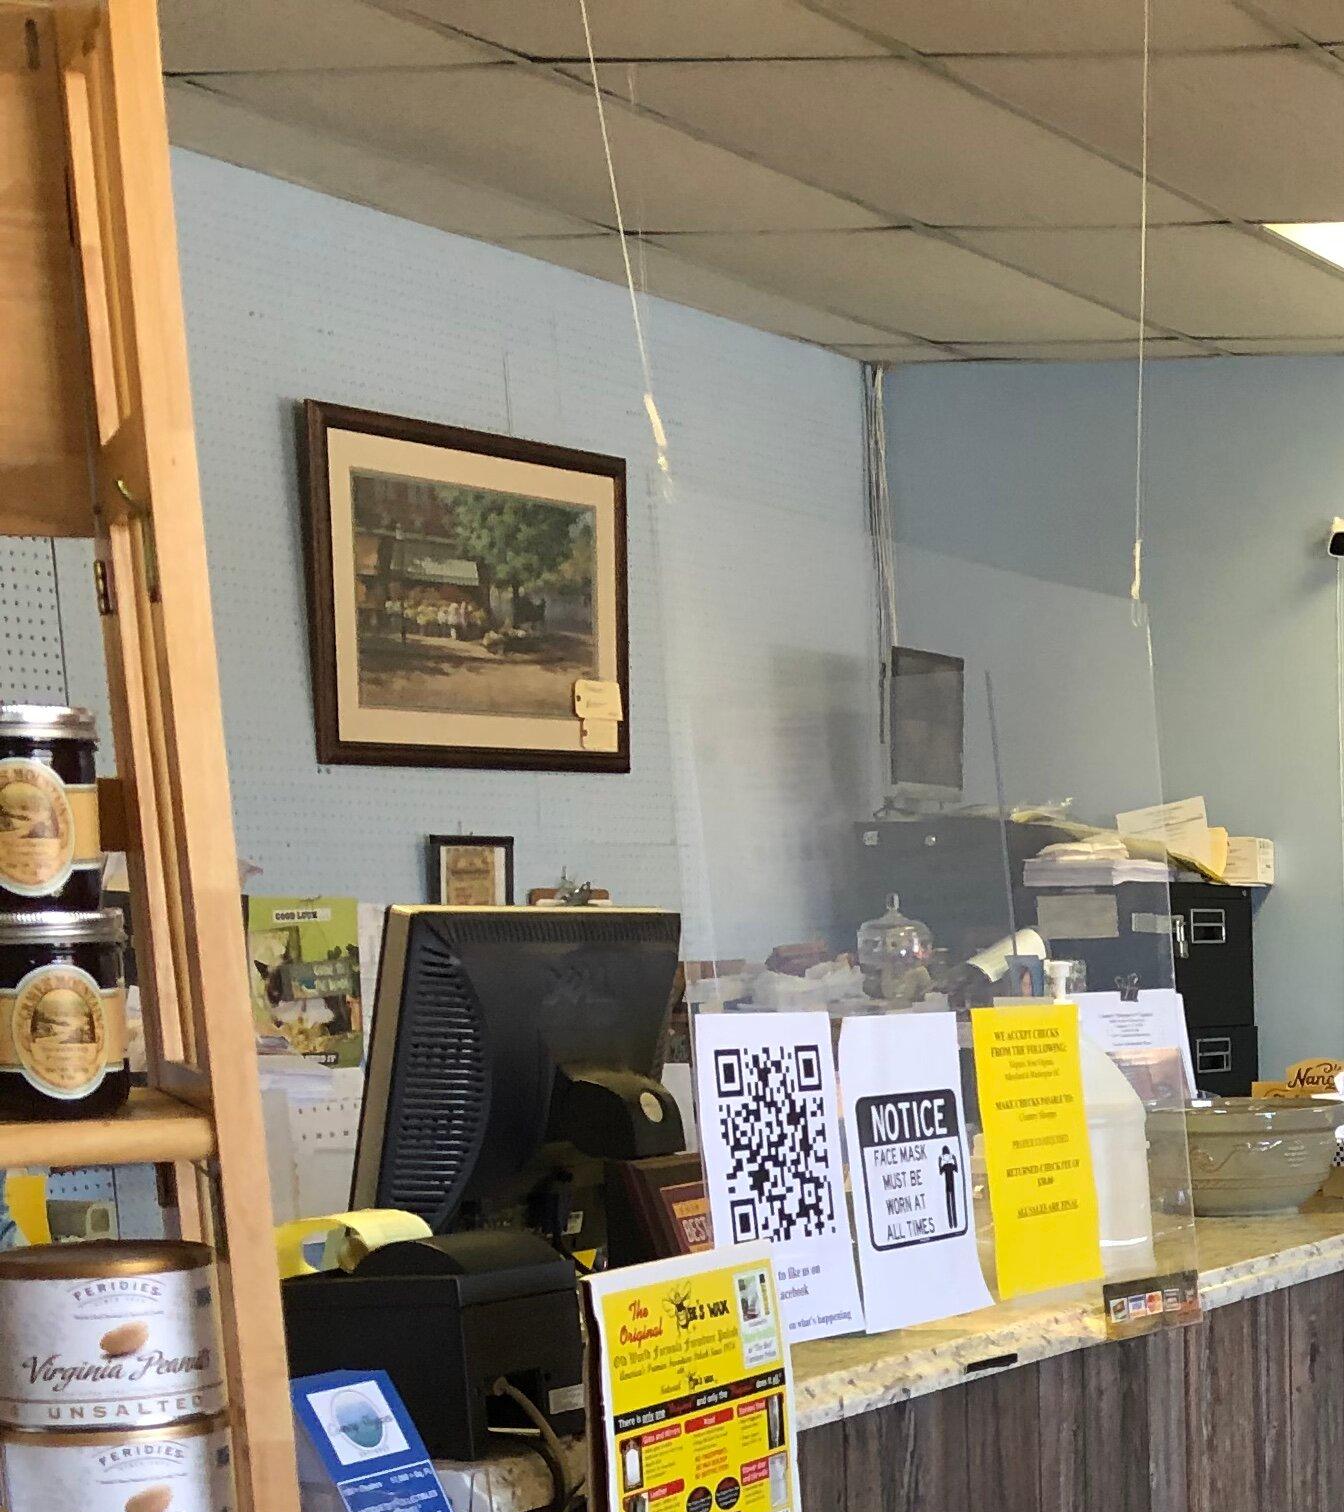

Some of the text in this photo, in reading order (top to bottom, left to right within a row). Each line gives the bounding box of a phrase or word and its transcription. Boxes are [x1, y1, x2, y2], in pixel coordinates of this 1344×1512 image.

[1032, 1028, 1060, 1040] CHECKS
[991, 1046, 1012, 1057] FROM
[870, 1098, 948, 1143] NOTICE
[874, 1144, 927, 1167] FACE MASK
[882, 1169, 923, 1191] MUST BE
[886, 1193, 926, 1216] WORN AT
[887, 1217, 936, 1241] ALL TIMES
[778, 1268, 786, 1281] to
[787, 1265, 801, 1280] like
[779, 1284, 809, 1301] acebook
[629, 1299, 648, 1321] The
[707, 1299, 731, 1319] WAX
[817, 1309, 852, 1326] happening
[619, 1317, 664, 1348] Original
[22, 1353, 124, 1392] Virginia
